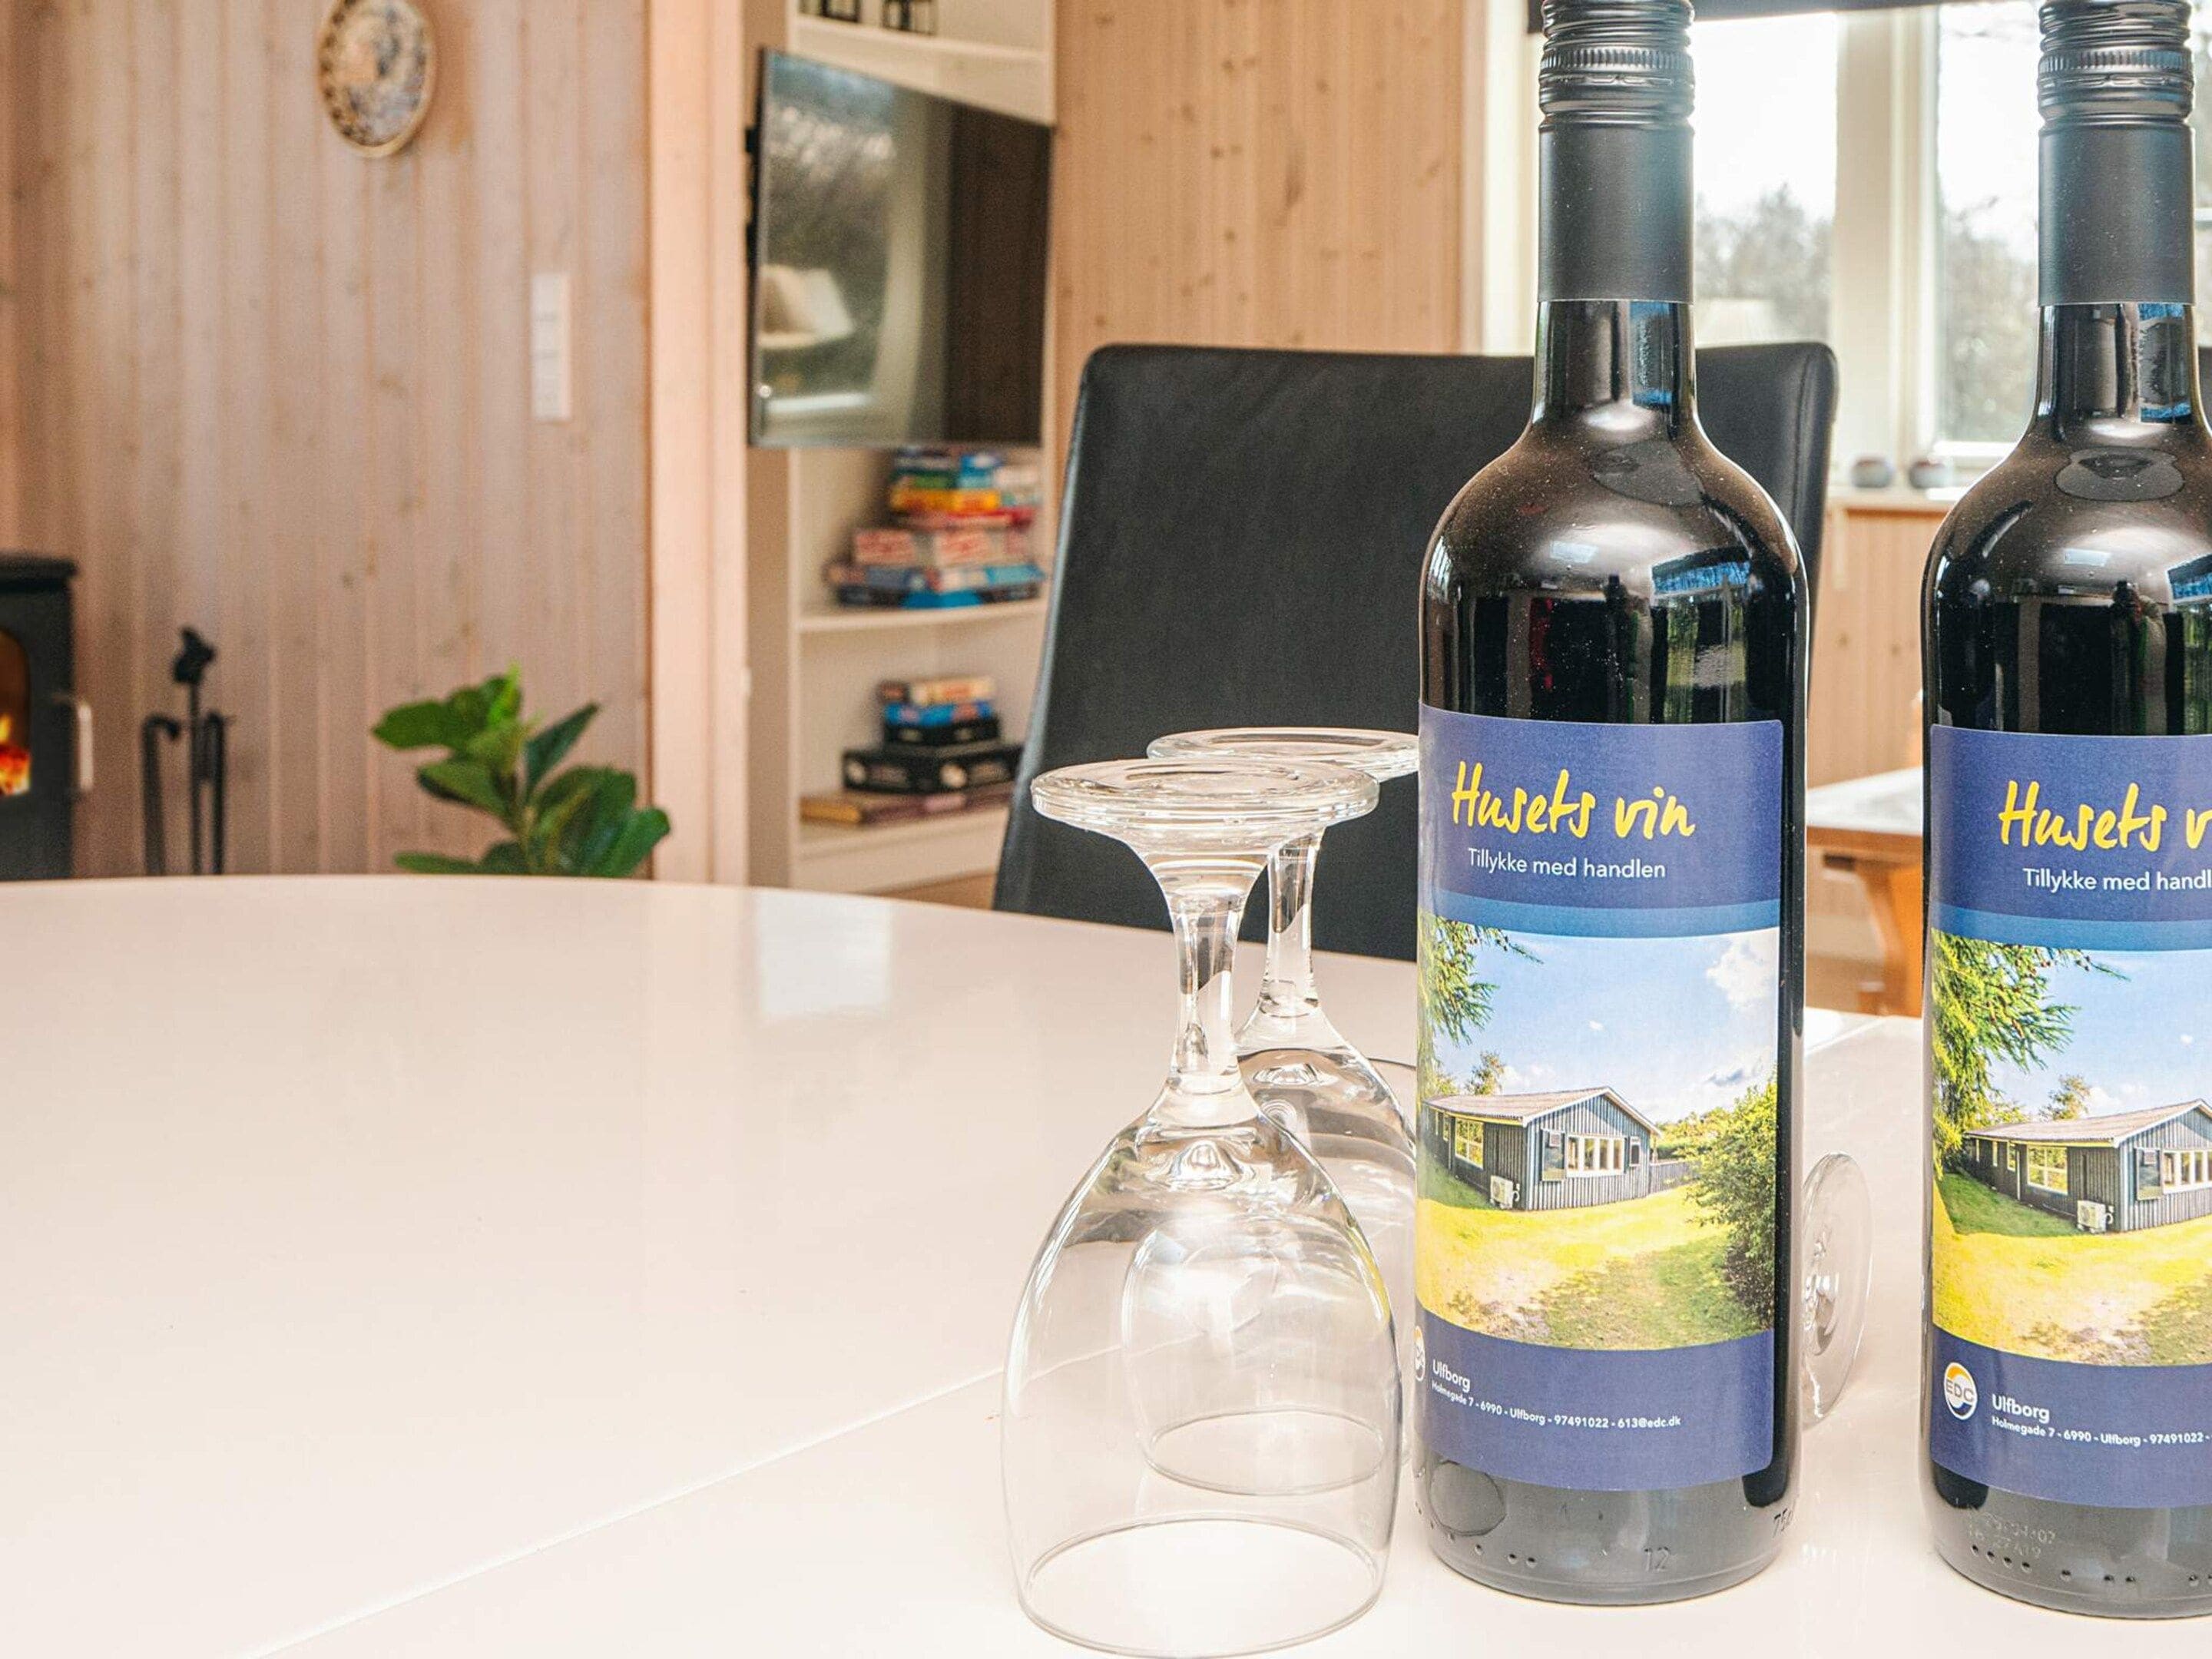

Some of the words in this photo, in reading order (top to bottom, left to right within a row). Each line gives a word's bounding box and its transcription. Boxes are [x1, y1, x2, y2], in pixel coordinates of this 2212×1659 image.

[1451, 760, 1596, 839] Husets
[1614, 786, 1696, 840] vin
[1998, 780, 2167, 852] Husets
[1469, 848, 1528, 873] Tillykke
[1533, 856, 1577, 877] med
[1583, 859, 1666, 879] handlen
[2022, 867, 2097, 893] Tillykke
[2103, 872, 2151, 891] med
[2157, 869, 2212, 890] handl
[1432, 1359, 1471, 1393] Ulfborg
[1945, 1378, 1975, 1402] EDC
[1468, 1396, 1475, 1407] 7
[1480, 1400, 1502, 1416] 6990
[1509, 1407, 1546, 1426] Ulfborg
[1554, 1414, 1609, 1429] 97491022
[1618, 1415, 1682, 1429] 613@edc.dk
[1992, 1393, 2050, 1424] Ulfborg
[1991, 1416, 2046, 1436] Holmegade
[2048, 1427, 2055, 1438] 7
[2063, 1429, 2092, 1442] 6990
[2100, 1432, 2141, 1448] Ulfborg
[2149, 1432, 2204, 1445] 97491022
